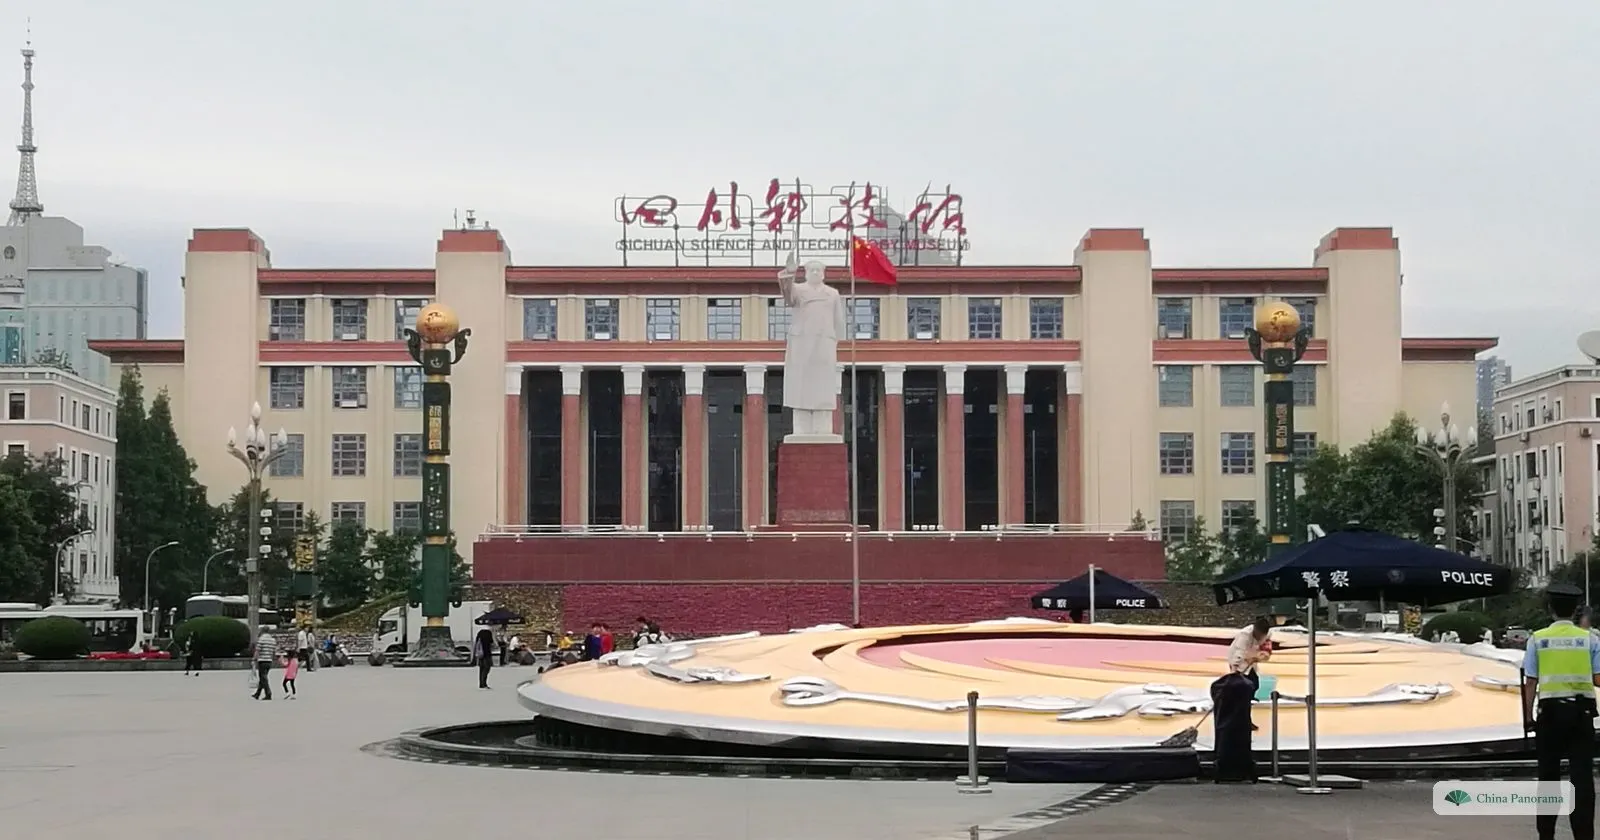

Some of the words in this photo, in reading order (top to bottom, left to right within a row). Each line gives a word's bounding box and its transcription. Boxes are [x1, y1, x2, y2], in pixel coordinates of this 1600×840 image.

[619, 239, 685, 251] SICHUAN
[695, 239, 756, 251] SCIENCE
[762, 239, 792, 251] AND
[905, 239, 970, 251] MUSEUM
[1301, 570, 1350, 588] 警察
[1441, 570, 1493, 587] POLICE
[1115, 598, 1146, 608] POLICE
